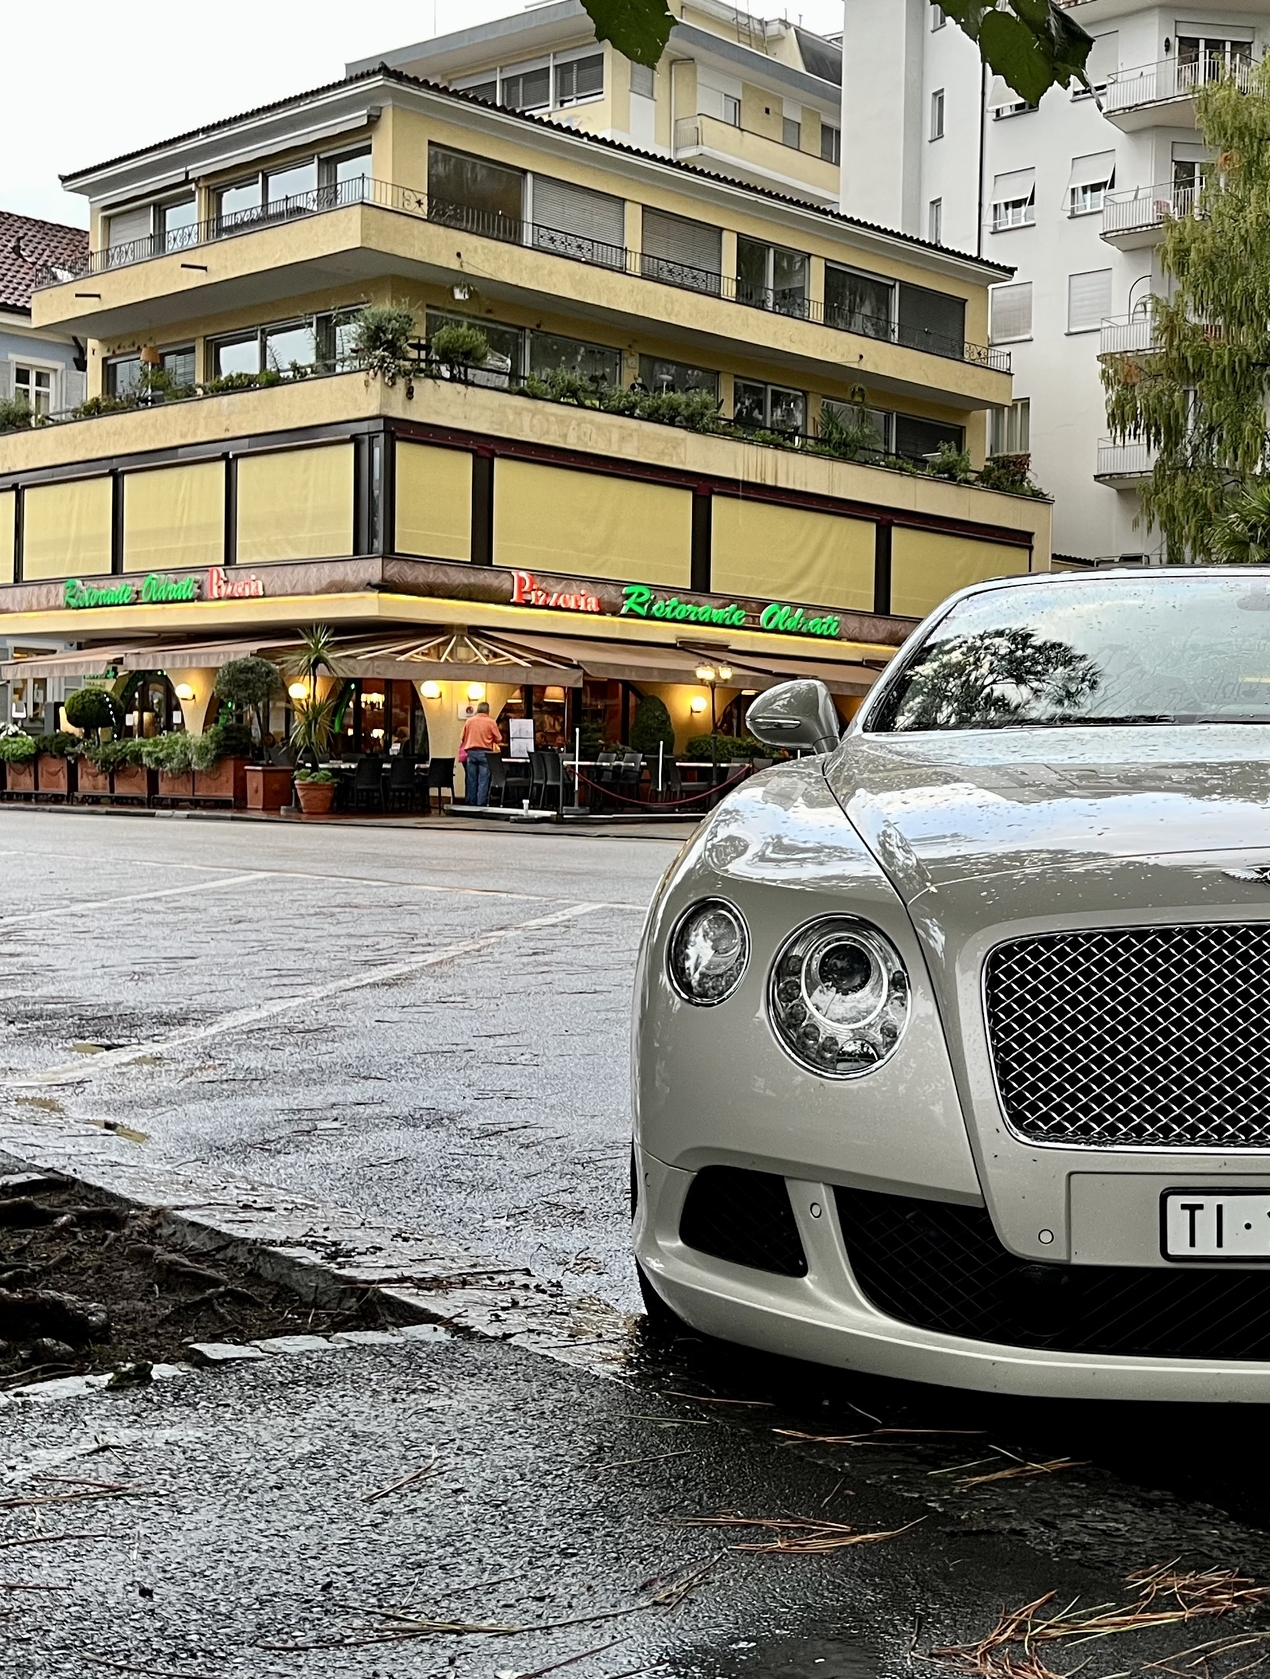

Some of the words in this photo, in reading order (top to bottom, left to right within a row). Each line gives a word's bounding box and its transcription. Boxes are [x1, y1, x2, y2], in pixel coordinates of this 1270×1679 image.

[64, 578, 134, 609] Ristorante
[510, 571, 600, 613] Pizzeria
[620, 585, 747, 627] Ristorante
